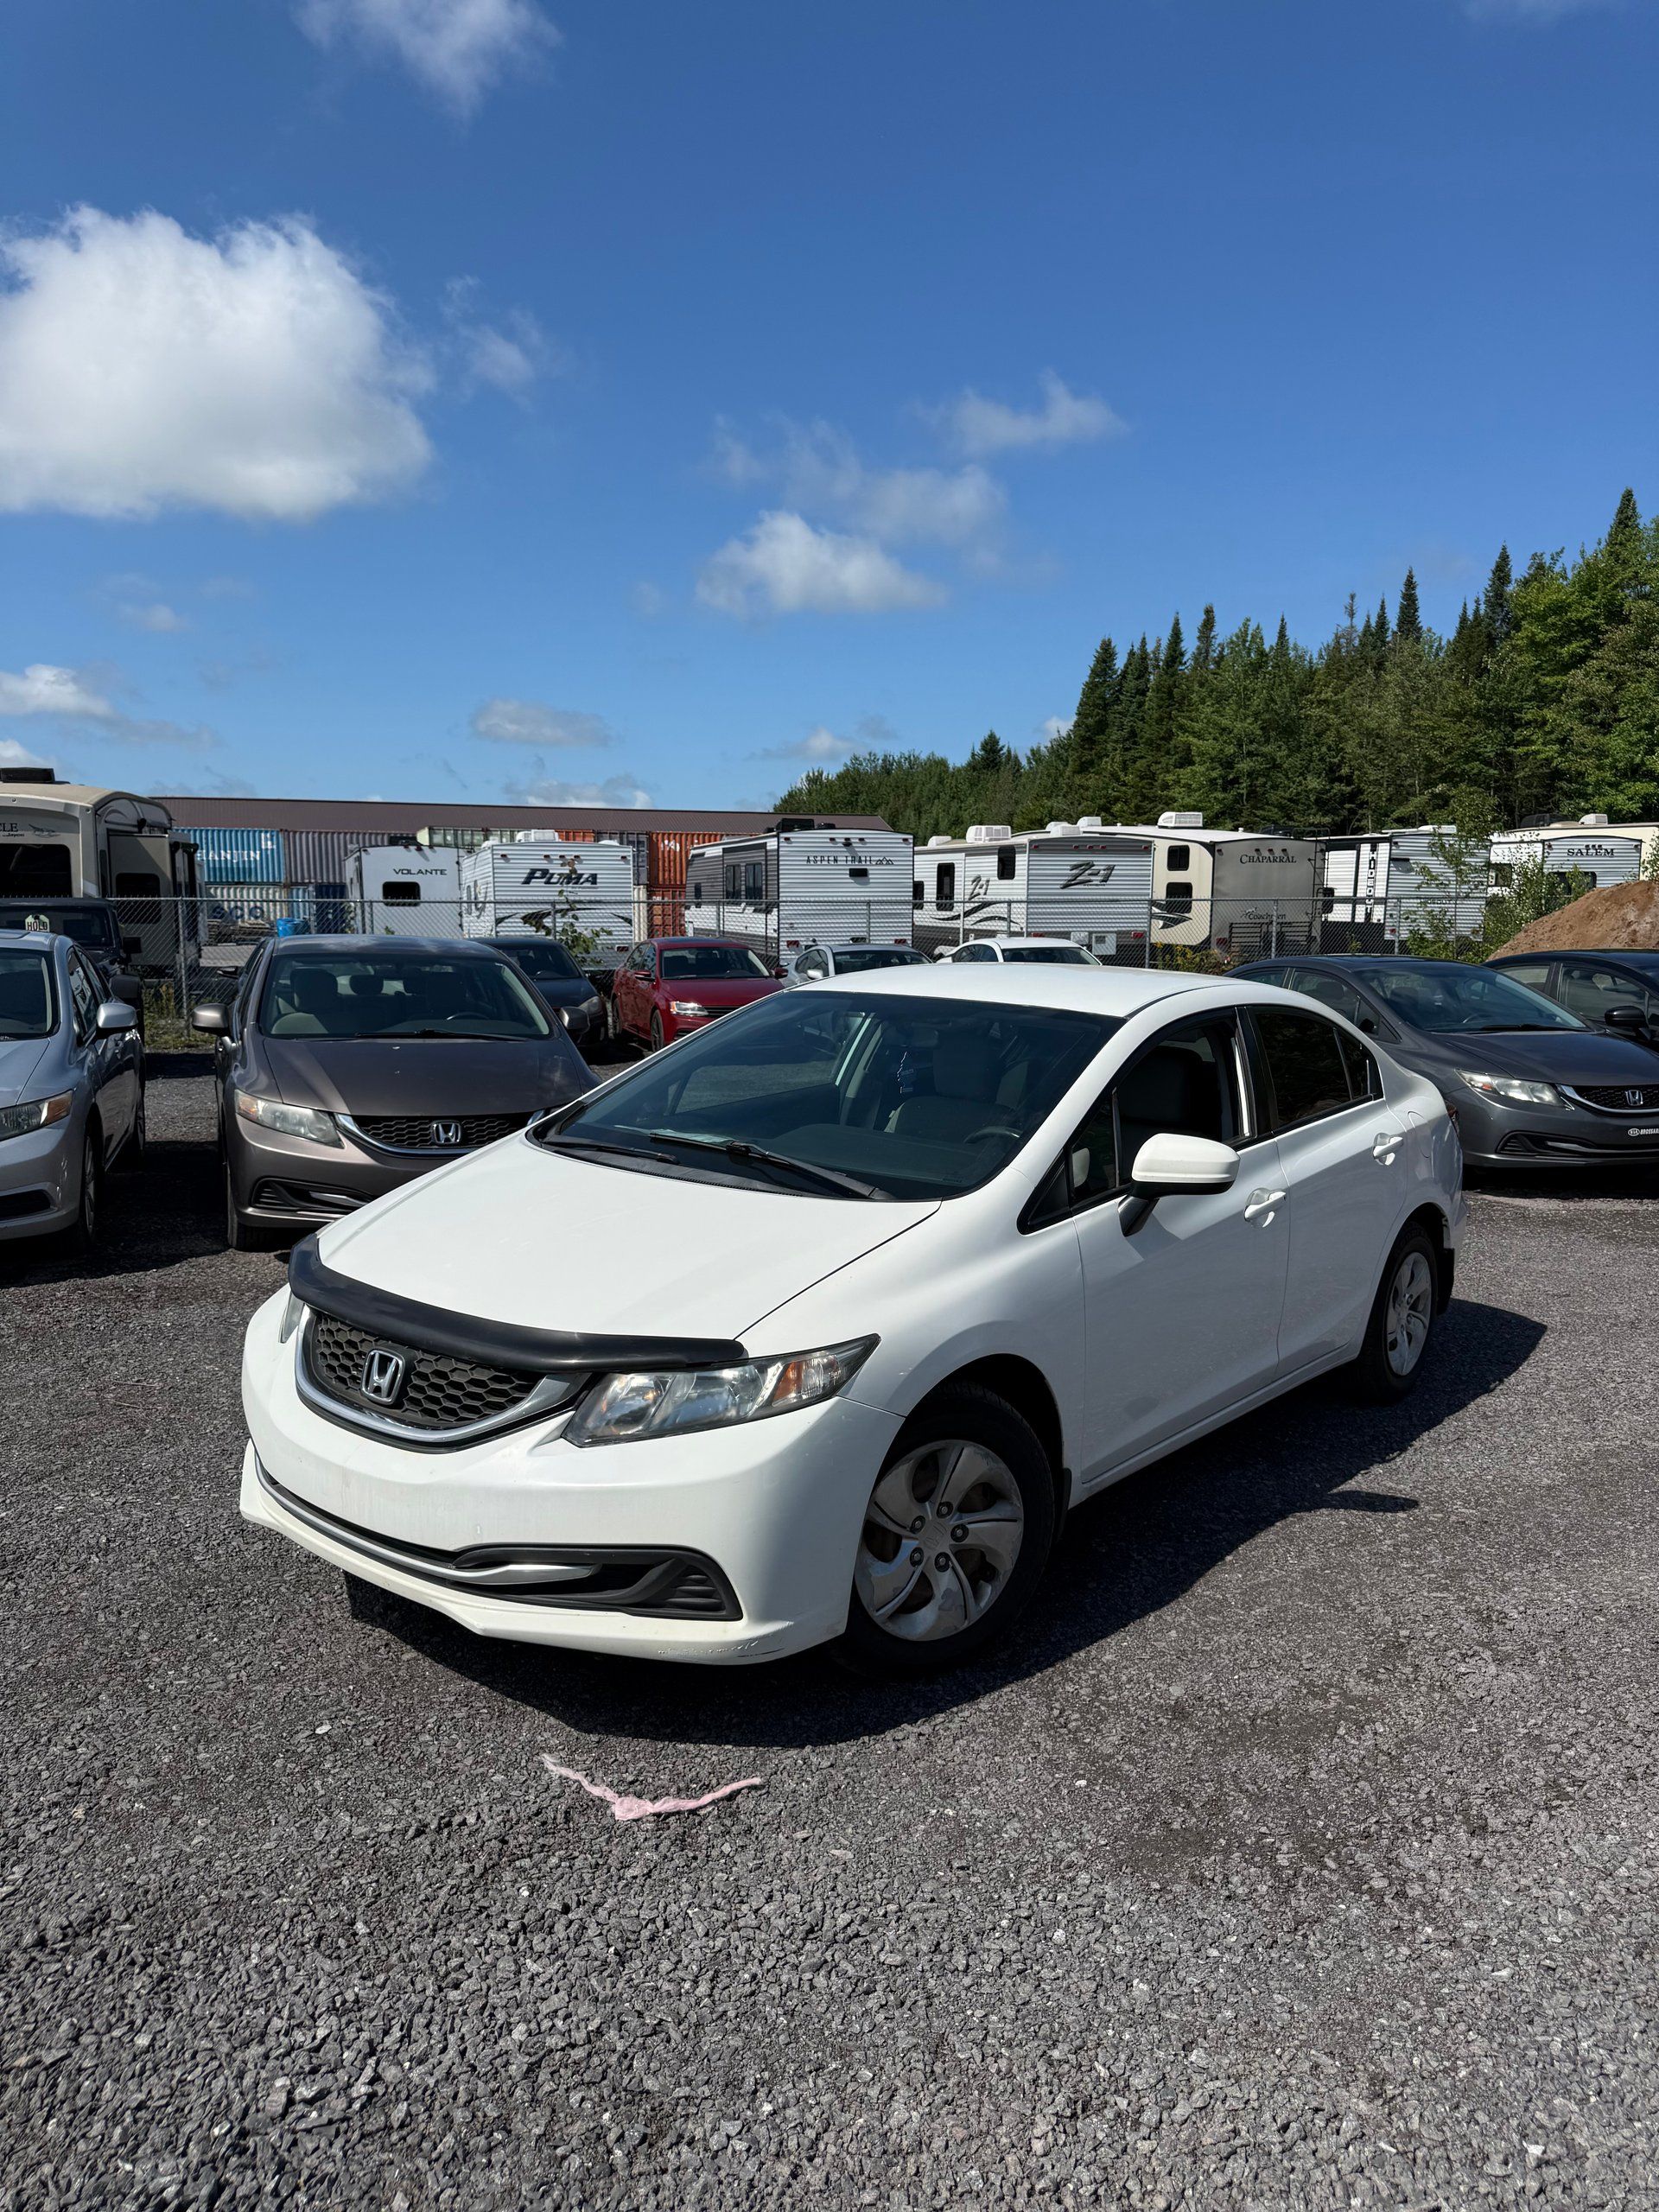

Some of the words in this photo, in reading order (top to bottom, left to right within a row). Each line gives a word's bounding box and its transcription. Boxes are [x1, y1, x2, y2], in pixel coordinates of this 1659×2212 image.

[196, 850, 260, 863] HANJIN
[1567, 848, 1616, 856] SALEM
[806, 855, 838, 864] ASPEN
[845, 855, 874, 864] TRAIL
[1240, 854, 1297, 865] CHAPARRAL
[27, 921, 48, 931] HOLD
